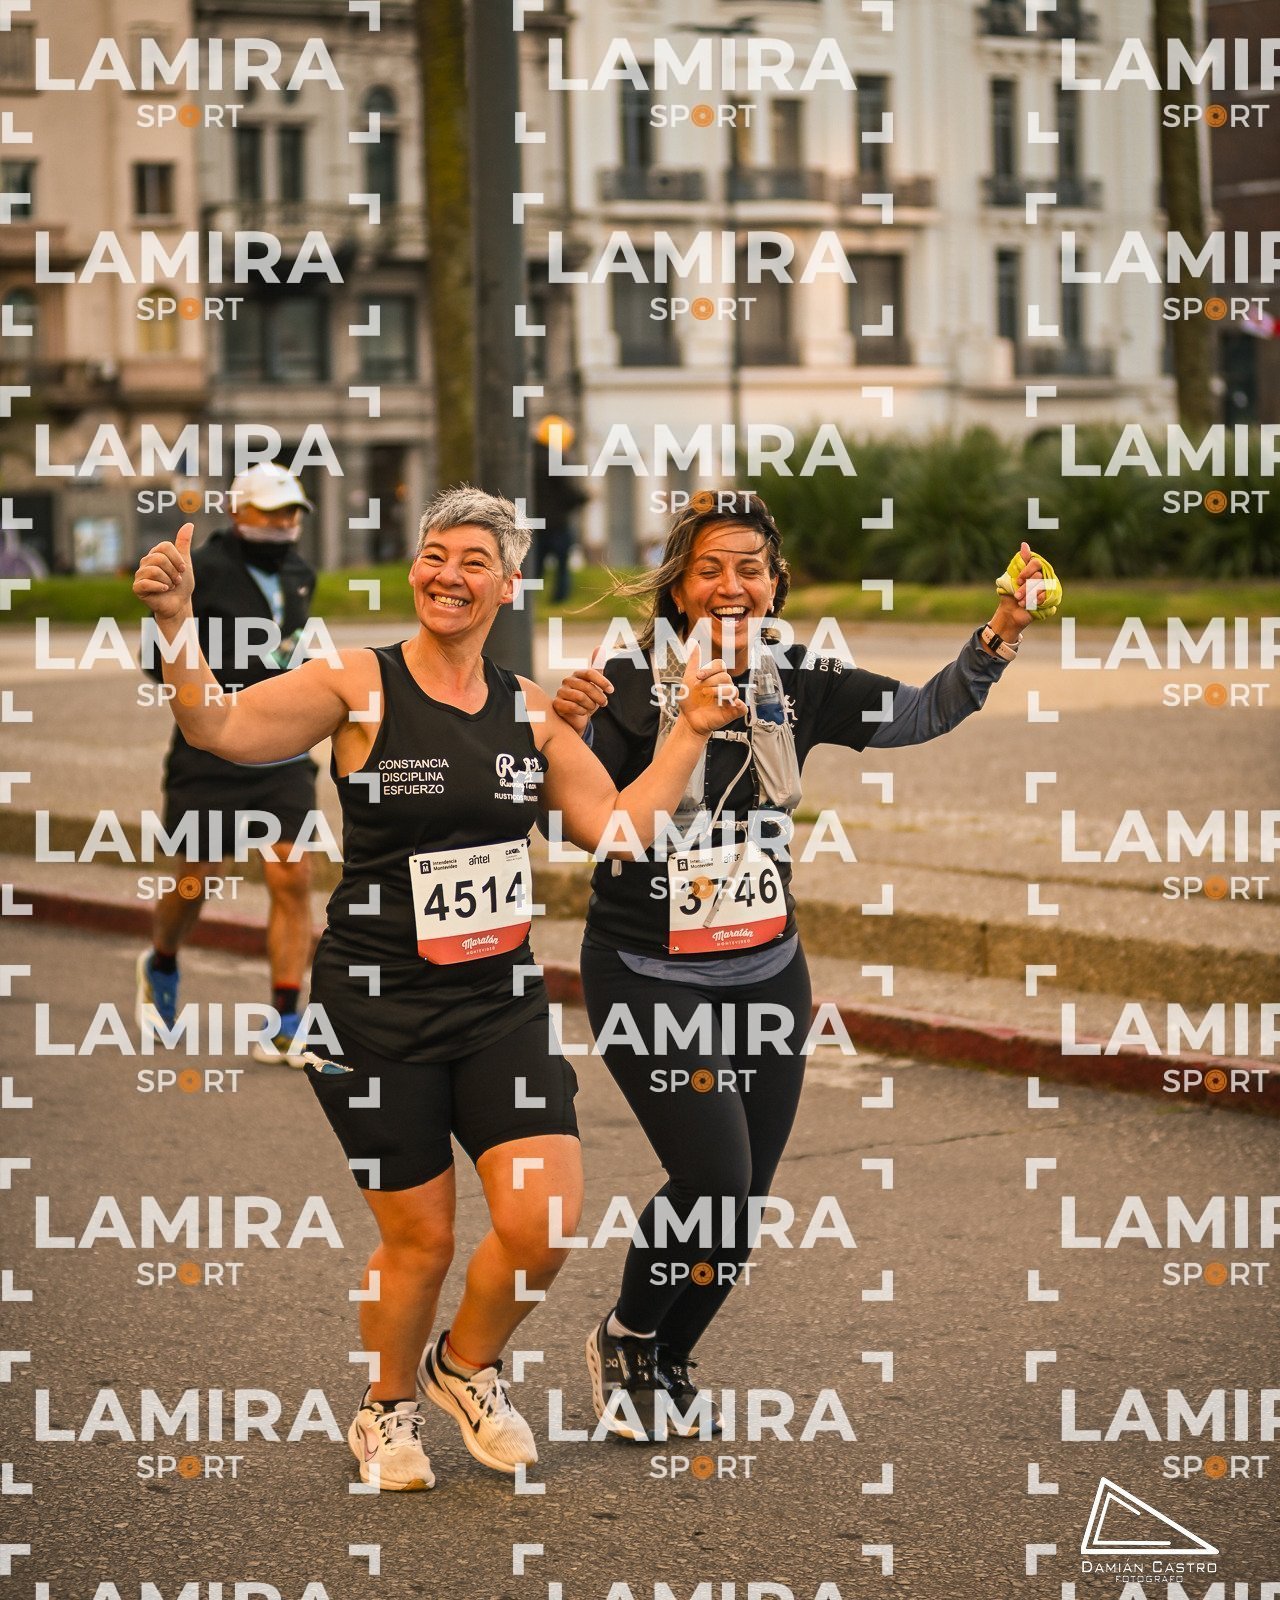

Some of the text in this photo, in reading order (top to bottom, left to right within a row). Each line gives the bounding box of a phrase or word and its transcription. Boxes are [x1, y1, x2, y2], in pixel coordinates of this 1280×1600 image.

[378, 758, 450, 770] CONSTANCIA
[382, 771, 445, 783] DISCIPLINA
[383, 784, 445, 796] ESFUERZO
[468, 854, 490, 866] antel
[424, 871, 526, 921] 4514
[712, 928, 754, 941] Maratón
[462, 934, 499, 950] Maratón
